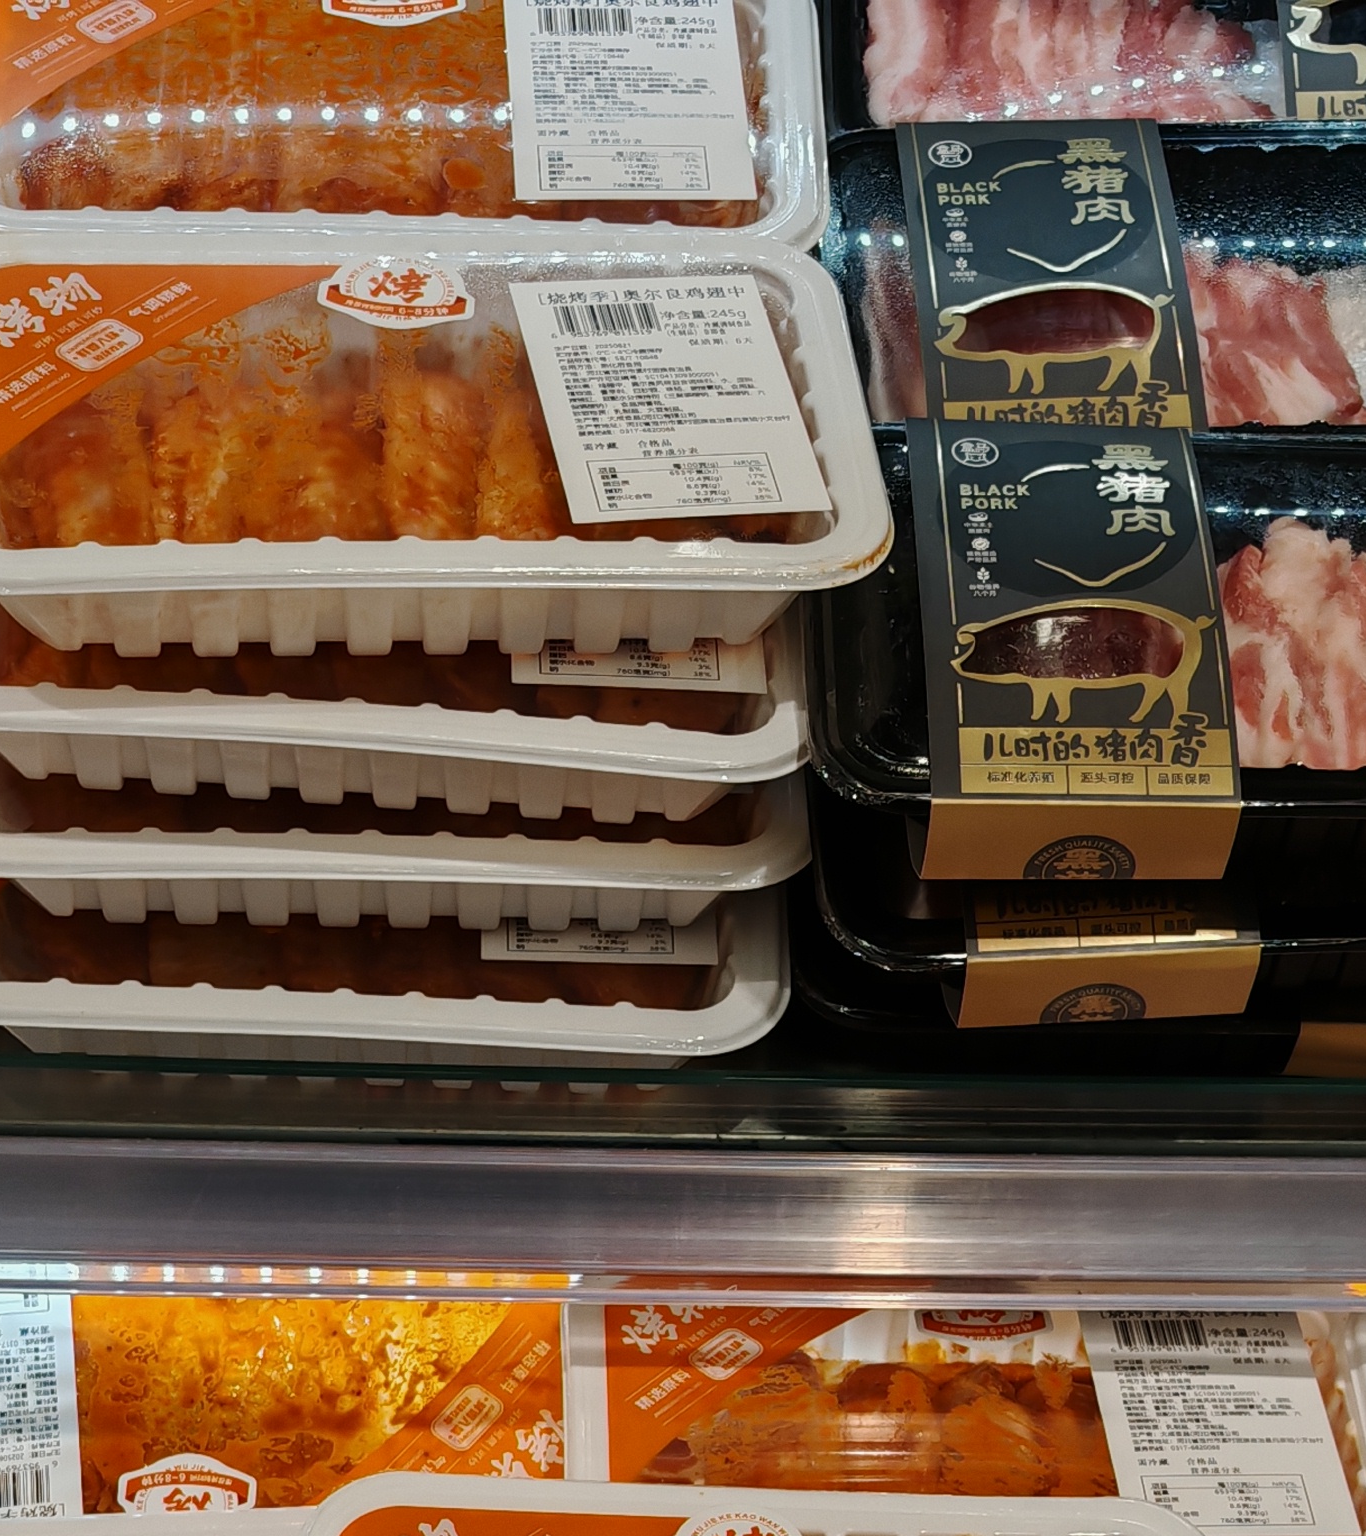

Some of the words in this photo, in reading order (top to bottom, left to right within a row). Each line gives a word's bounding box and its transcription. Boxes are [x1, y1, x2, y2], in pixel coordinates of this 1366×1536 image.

[937, 181, 1002, 193] BLACK
[1057, 138, 1135, 225] 黑猪肉
[938, 194, 990, 206] PORK
[959, 483, 1030, 496] BLACK
[1092, 444, 1176, 537] 黑猪肉
[960, 498, 1019, 510] PORK
